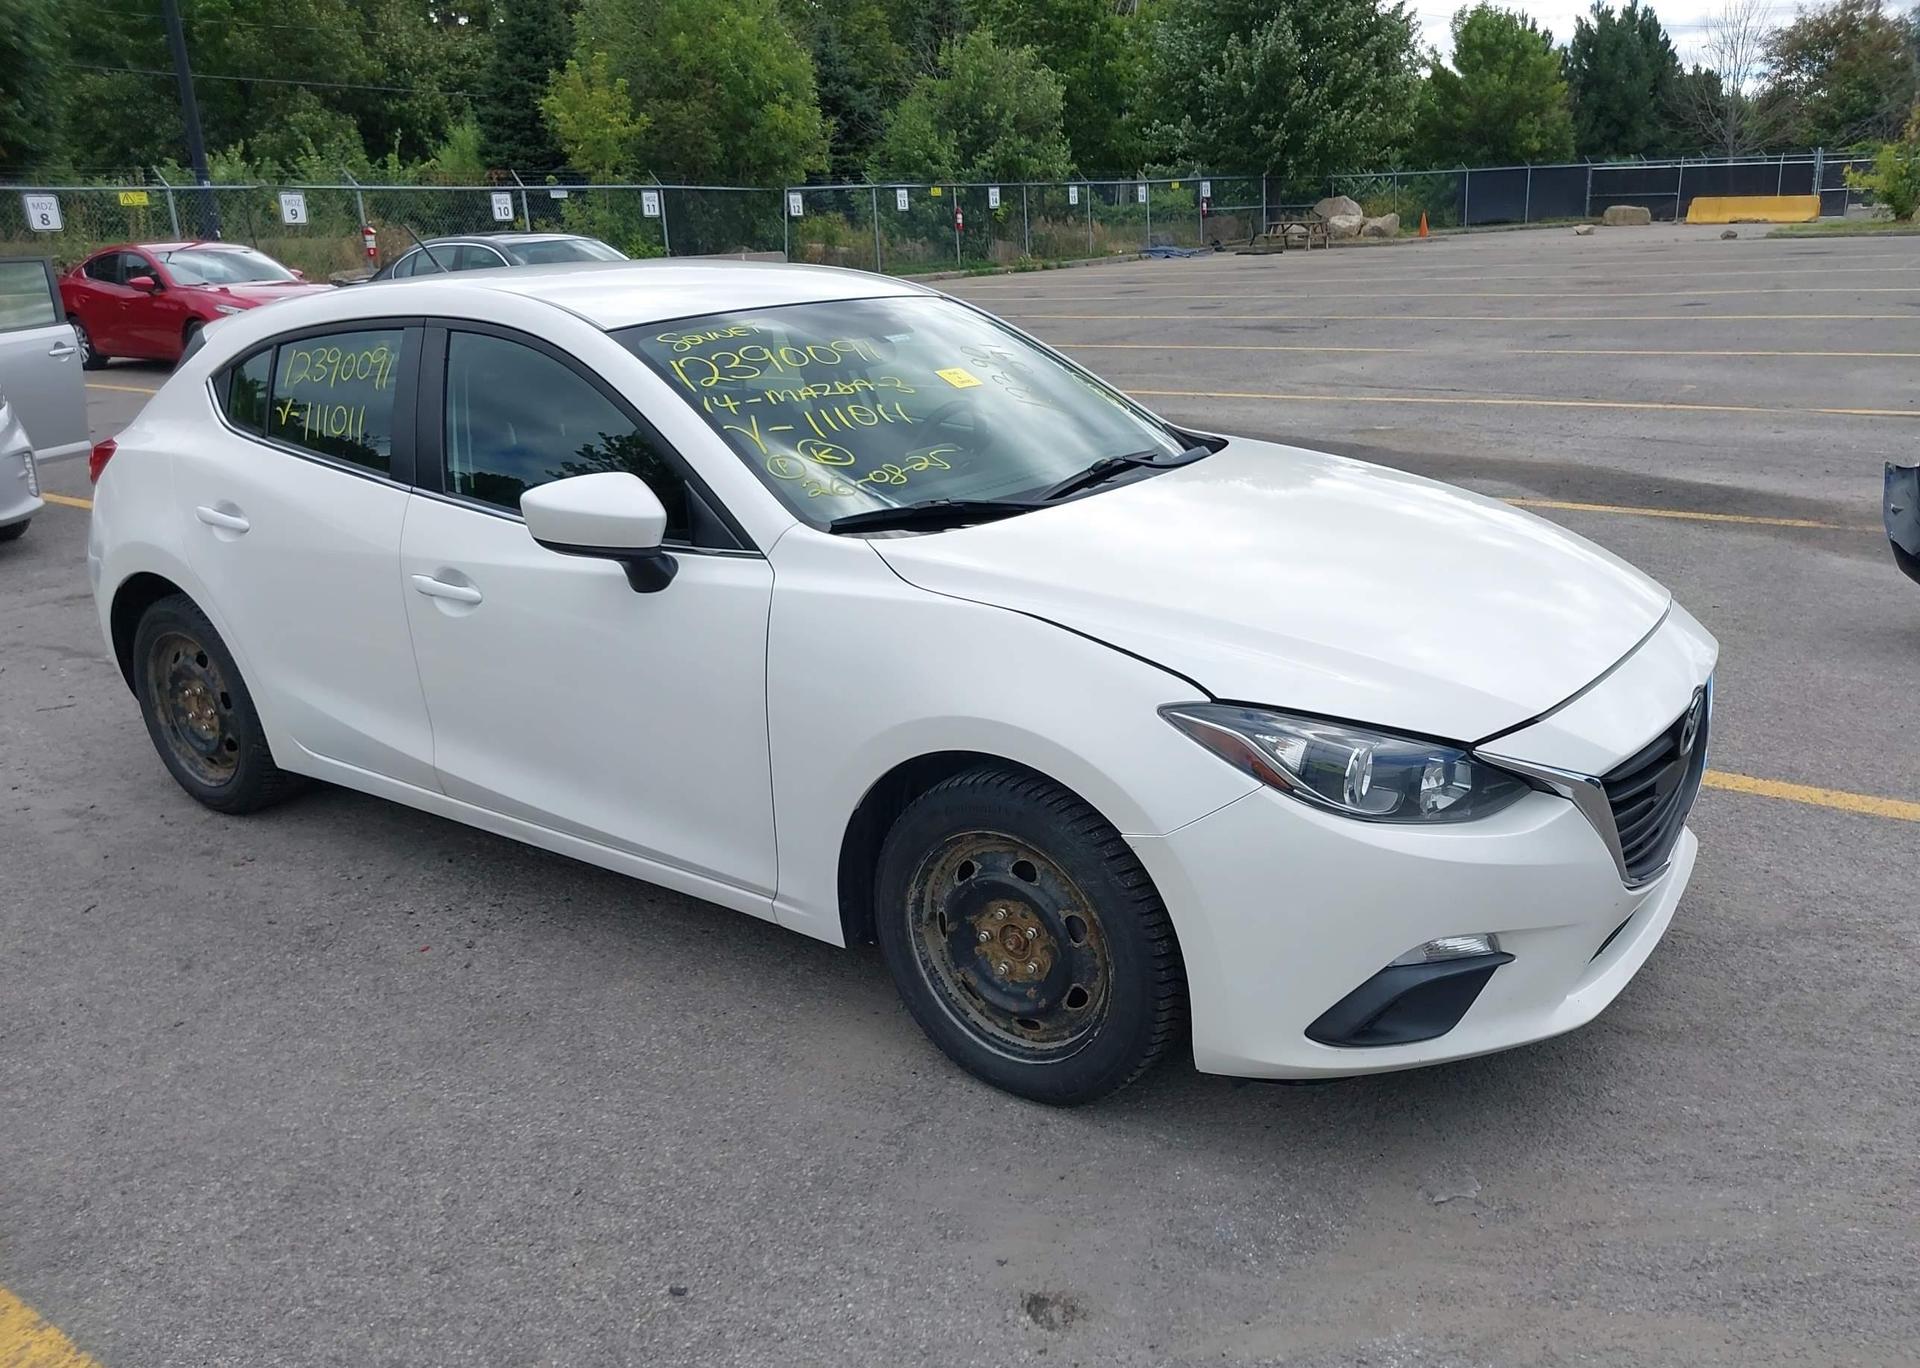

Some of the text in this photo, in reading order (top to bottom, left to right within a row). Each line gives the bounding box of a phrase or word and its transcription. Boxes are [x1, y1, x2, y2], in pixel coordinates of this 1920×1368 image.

[31, 202, 54, 211] MDZ
[498, 206, 510, 217] 10
[647, 203, 656, 213] 11
[793, 204, 802, 214] 12
[40, 213, 51, 226] 8
[290, 208, 298, 220] 9
[284, 346, 396, 391] 12390091
[669, 340, 883, 393] 12390091
